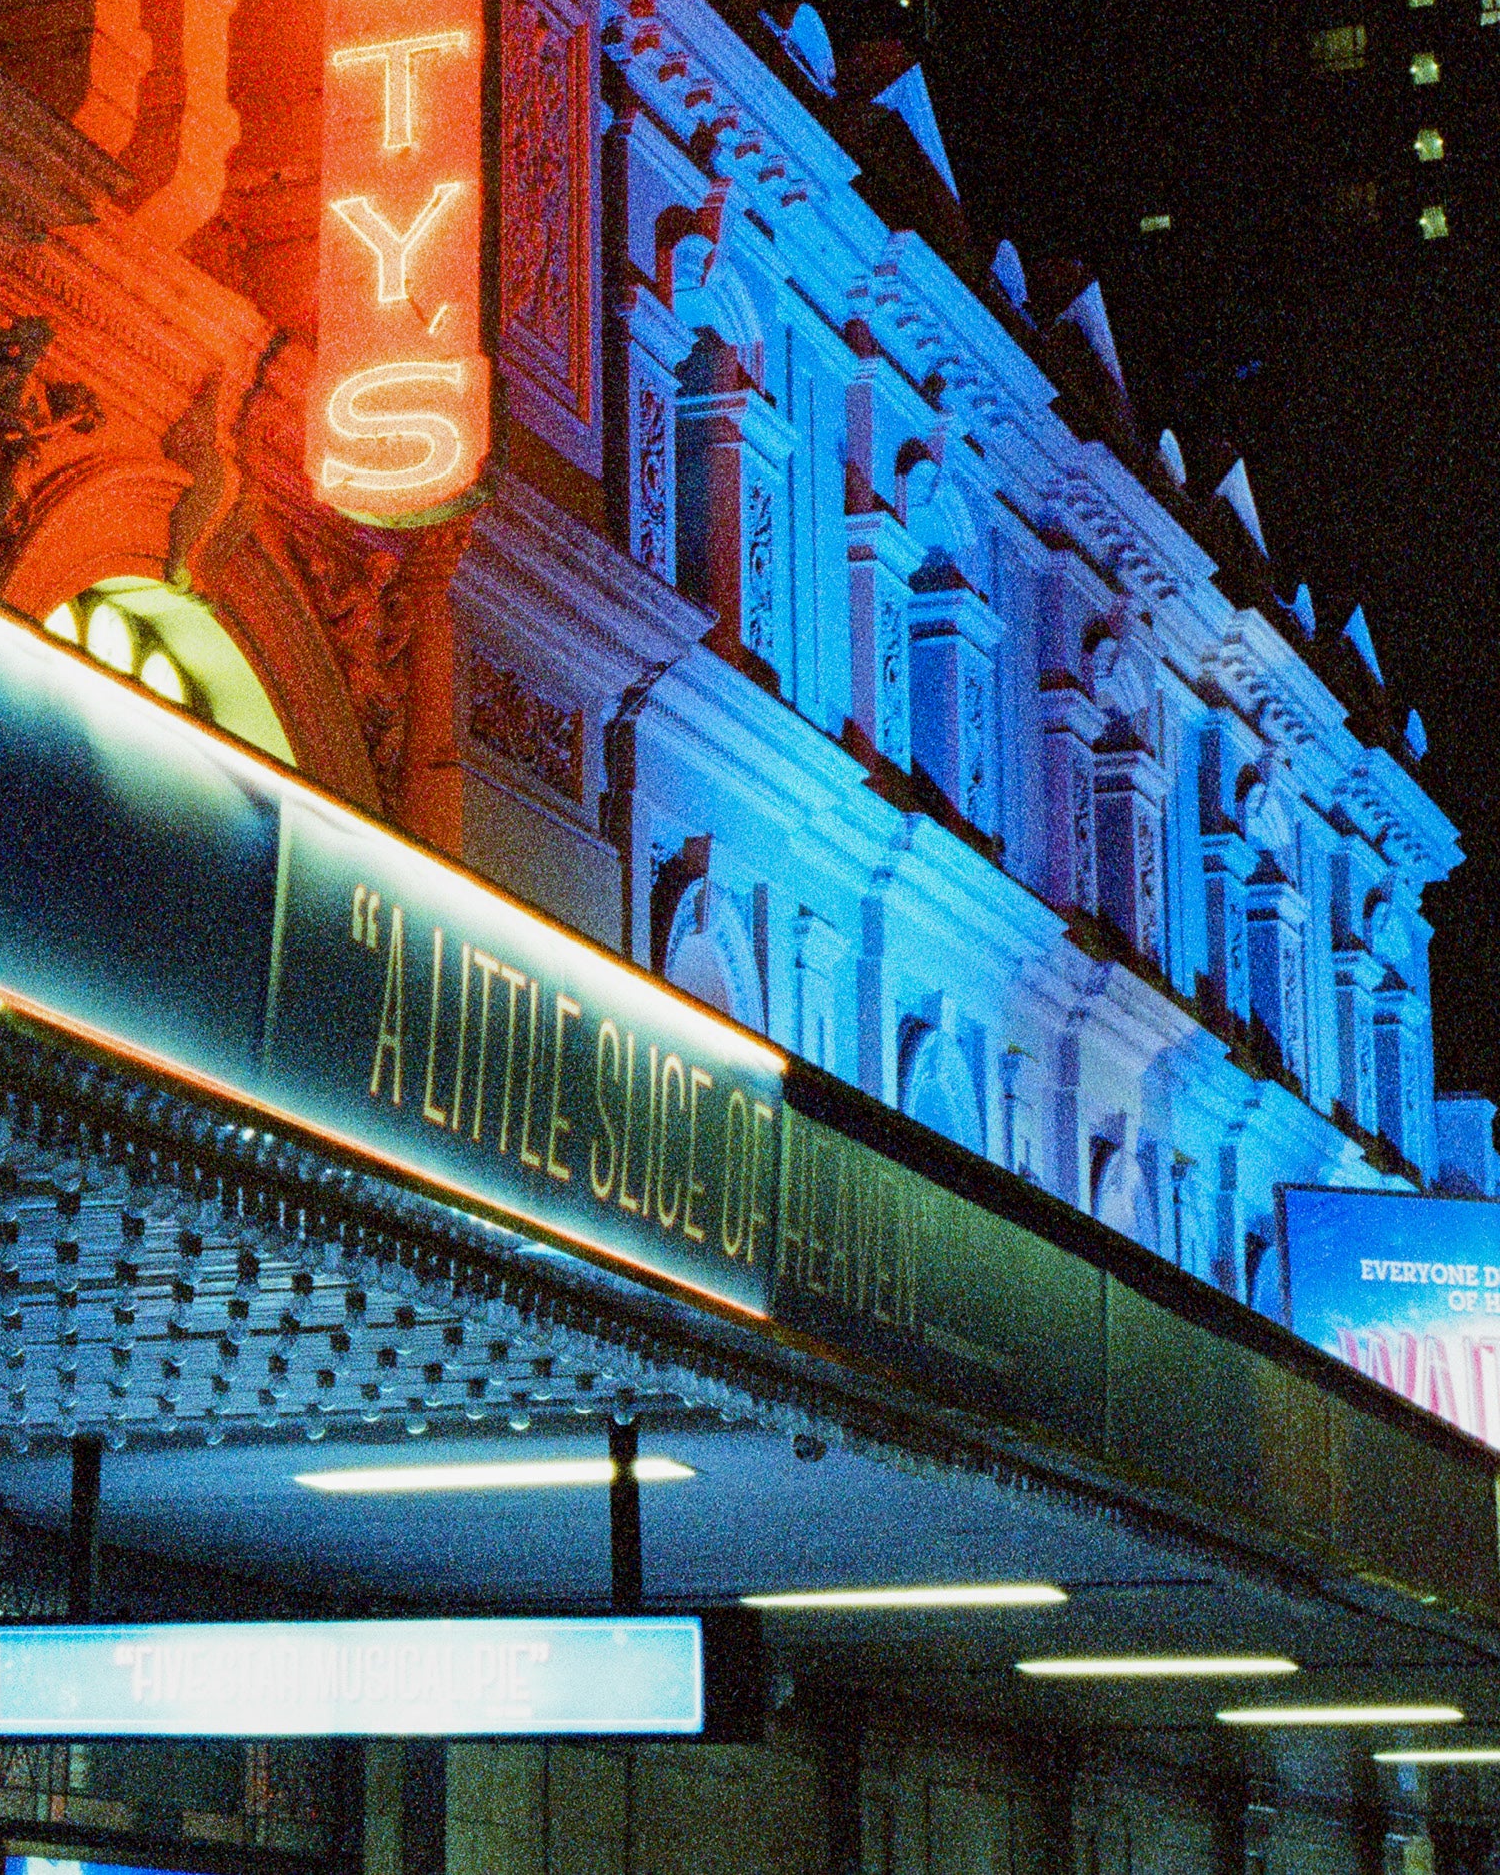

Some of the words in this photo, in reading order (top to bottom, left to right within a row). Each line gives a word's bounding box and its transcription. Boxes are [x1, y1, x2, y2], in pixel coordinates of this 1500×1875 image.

[423, 926, 582, 1182] LITTLE
[591, 1019, 713, 1241] SLICE
[722, 1089, 774, 1262] OF
[1360, 1259, 1479, 1287] EVERYONE
[1449, 1290, 1479, 1312] OF
